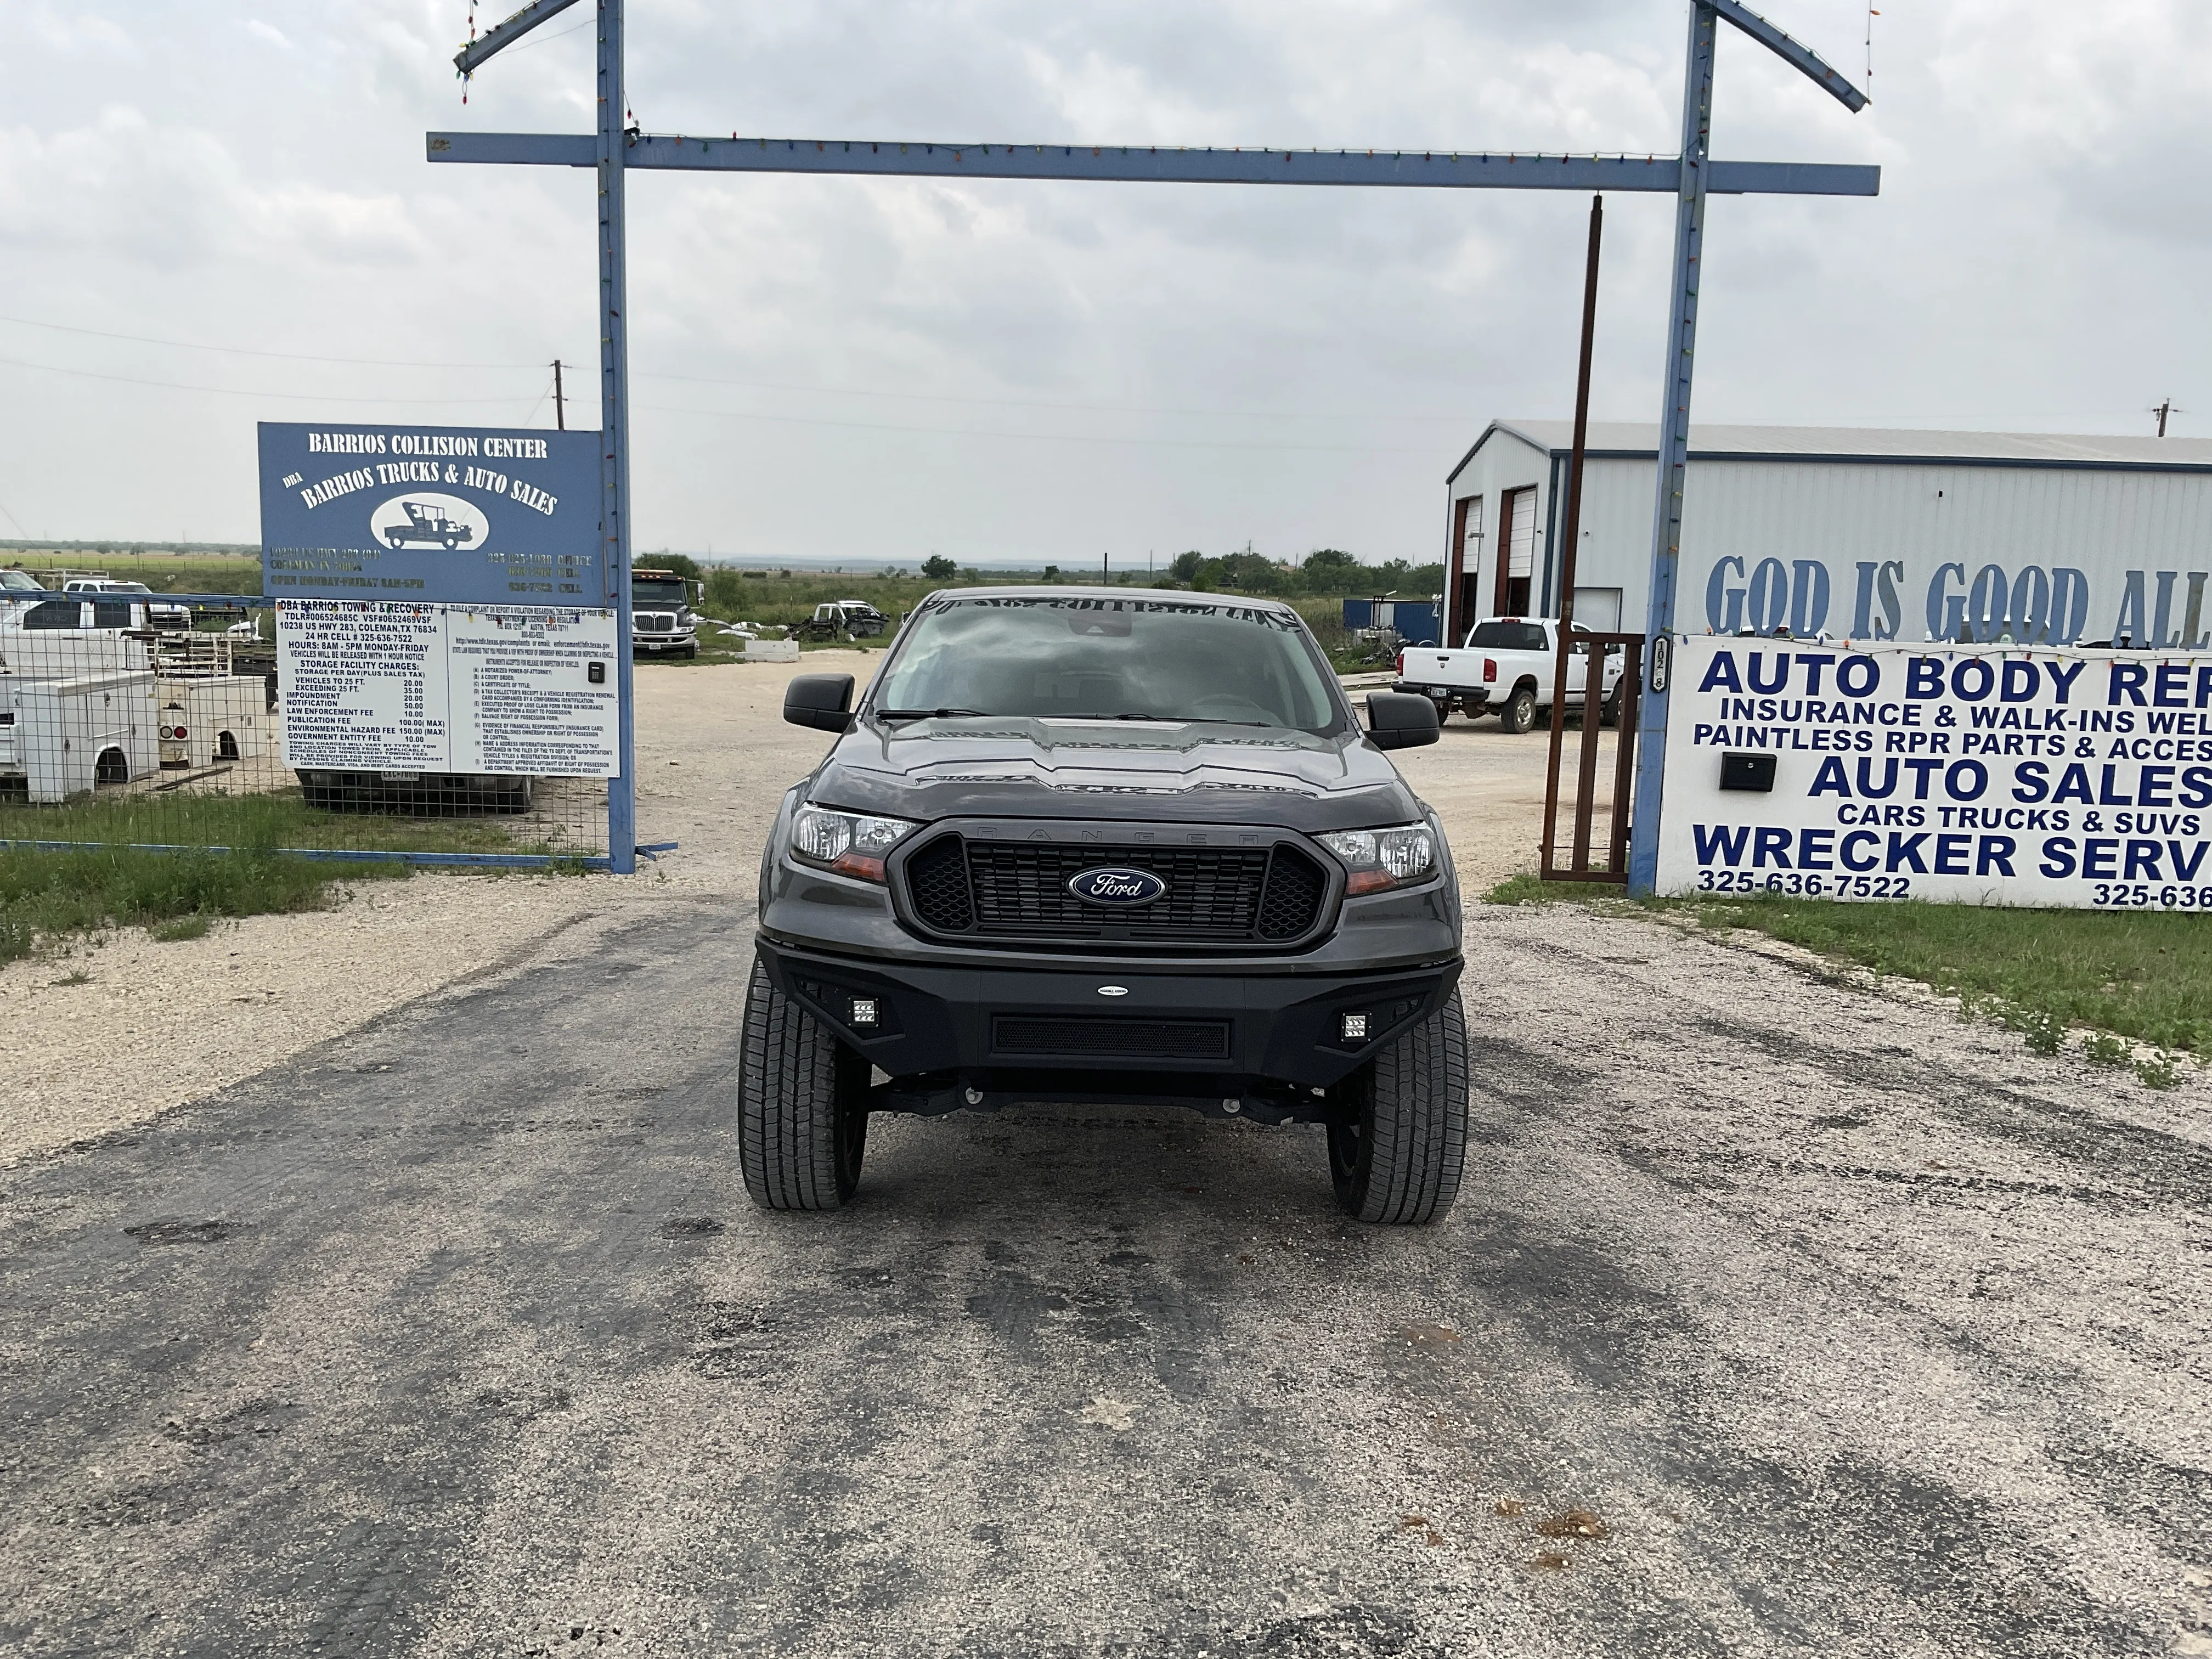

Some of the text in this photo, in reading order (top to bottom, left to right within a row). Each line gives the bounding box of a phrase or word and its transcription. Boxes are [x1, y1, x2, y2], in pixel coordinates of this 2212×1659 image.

[308, 433, 548, 459] BARRIOS COLLISION CENTER
[282, 472, 303, 488] DBA
[300, 461, 558, 516] BARRIOS TRUCKS & AUTO SALES
[558, 583, 583, 593] CELL
[281, 600, 298, 610] DBA
[301, 601, 338, 612] BARRIOS
[380, 602, 385, 612] &
[388, 603, 434, 614] RECOVERY
[1706, 556, 2211, 650] GOD IS GOOD ALL
[279, 622, 302, 630] 10238
[319, 623, 336, 631] HWY
[340, 623, 356, 631] 283,
[358, 624, 410, 633] COLEMAN,TX
[286, 613, 431, 624] TDLR#006524685C VSF#0652469VSF
[289, 641, 319, 650] HOURS:
[364, 644, 428, 652] MONDAY-FRIDAY
[378, 662, 419, 670] CHARGES:
[1698, 651, 1880, 698] AUTO
[1905, 657, 2085, 704] BODY
[1722, 698, 1920, 727] INSURANCE
[1935, 704, 1955, 727] &
[1971, 706, 2134, 733] WALK-INS
[1694, 724, 2212, 762] PAINTLESS RPR PARTS & ACCES
[1808, 756, 2212, 808] AUTO SALES
[1838, 804, 2199, 836] CARS TRUCKS & SUVS
[977, 826, 1259, 845] RANGER
[1694, 825, 2208, 881] WRECKER SERV
[1091, 874, 1142, 897] Ford
[1697, 870, 2212, 907] 325-636-7522 325-636
